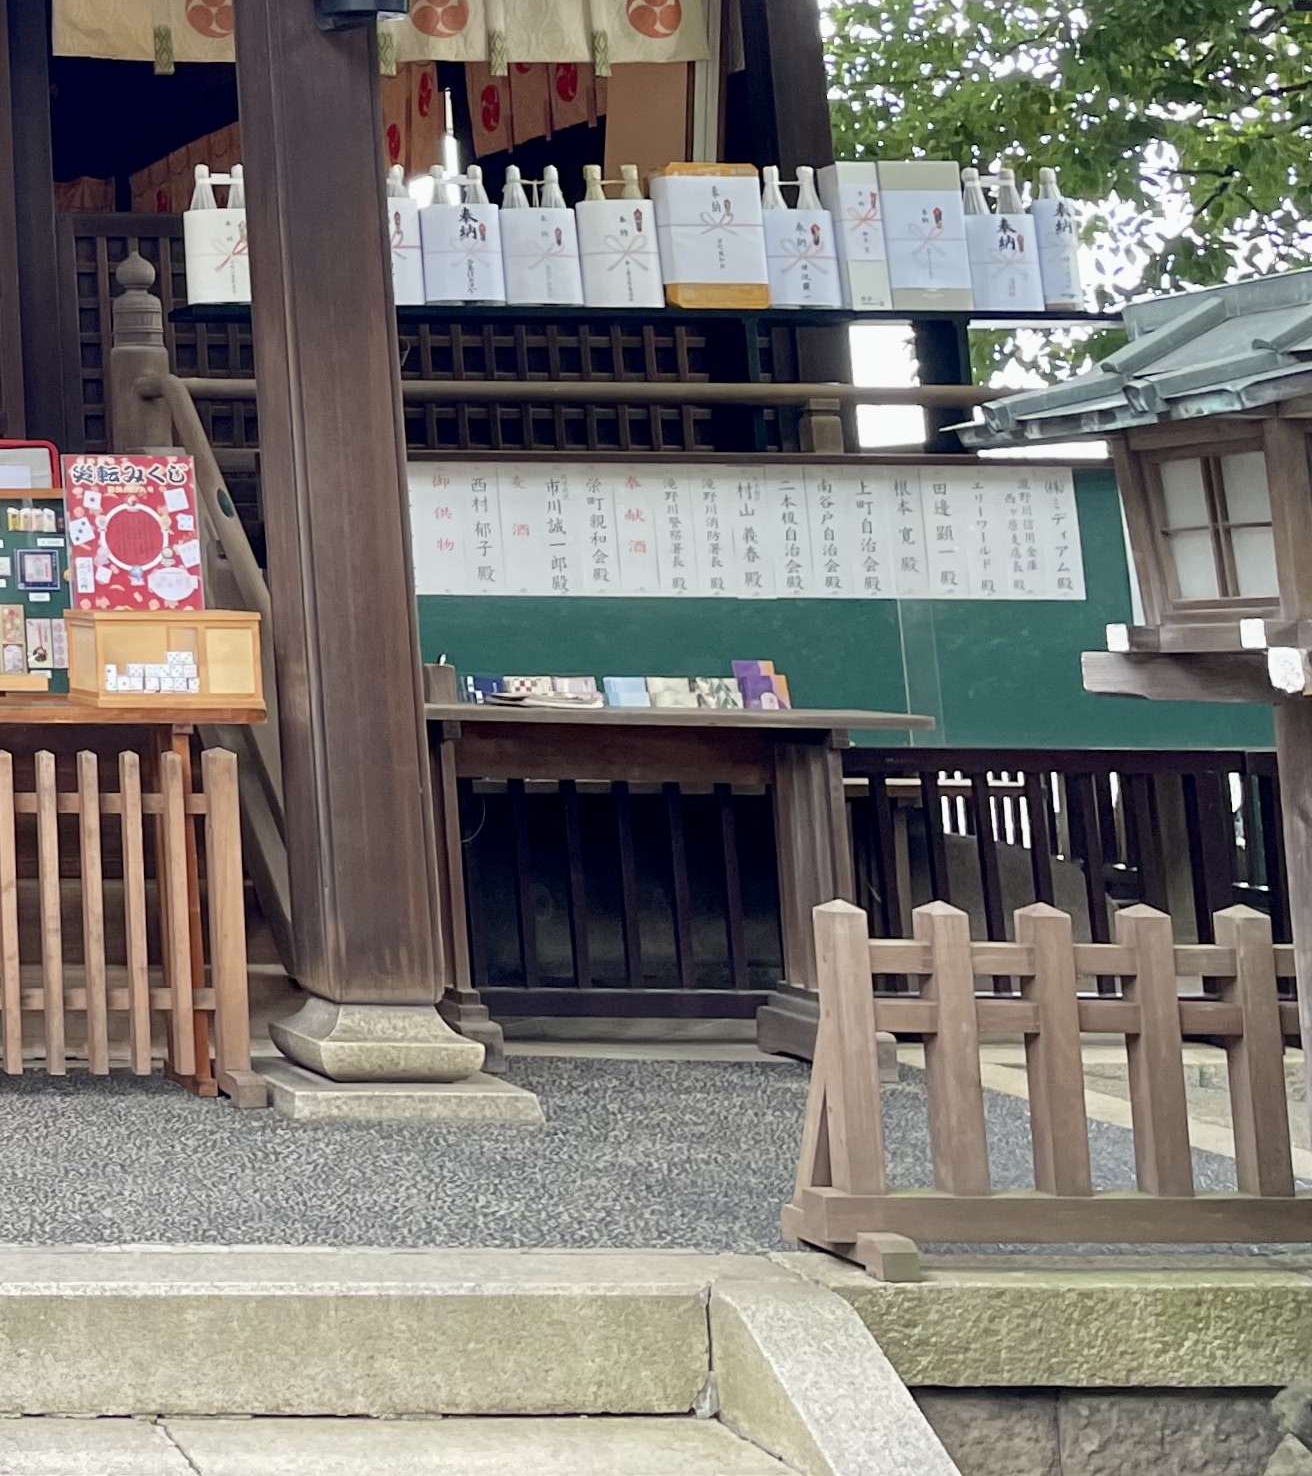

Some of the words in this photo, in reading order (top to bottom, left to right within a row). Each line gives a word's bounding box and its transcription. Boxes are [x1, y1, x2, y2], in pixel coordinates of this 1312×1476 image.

[73, 464, 188, 484] 災転みくじ
[471, 478, 496, 583] 西村郁子殿
[545, 478, 568, 591] 市川誠一郎殿
[856, 480, 881, 591] 上町自治会殿
